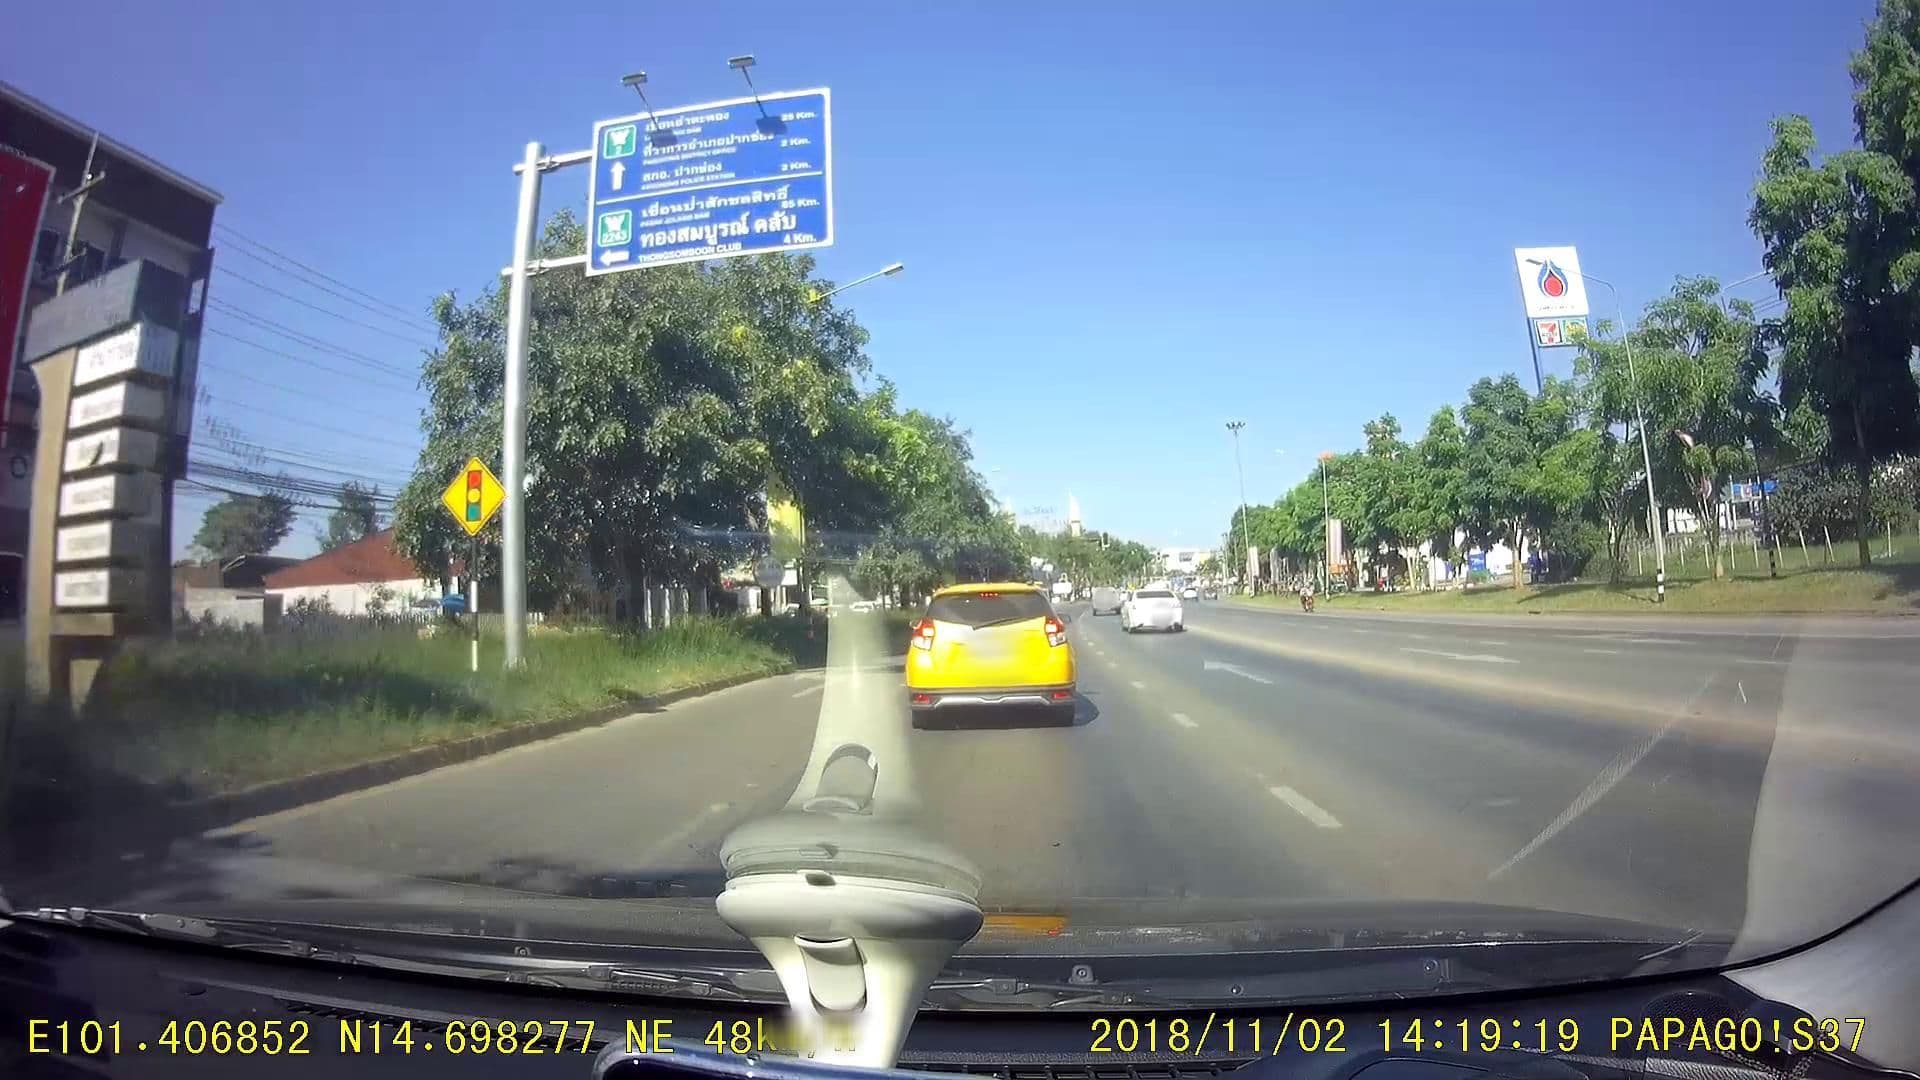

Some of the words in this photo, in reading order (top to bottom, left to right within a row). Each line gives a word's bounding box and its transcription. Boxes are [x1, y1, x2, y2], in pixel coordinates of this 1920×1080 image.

[640, 211, 750, 248] ทองสมบูรณ์
[754, 210, 797, 233] คลับ
[792, 232, 817, 244] Km.
[716, 242, 742, 253] CLUB
